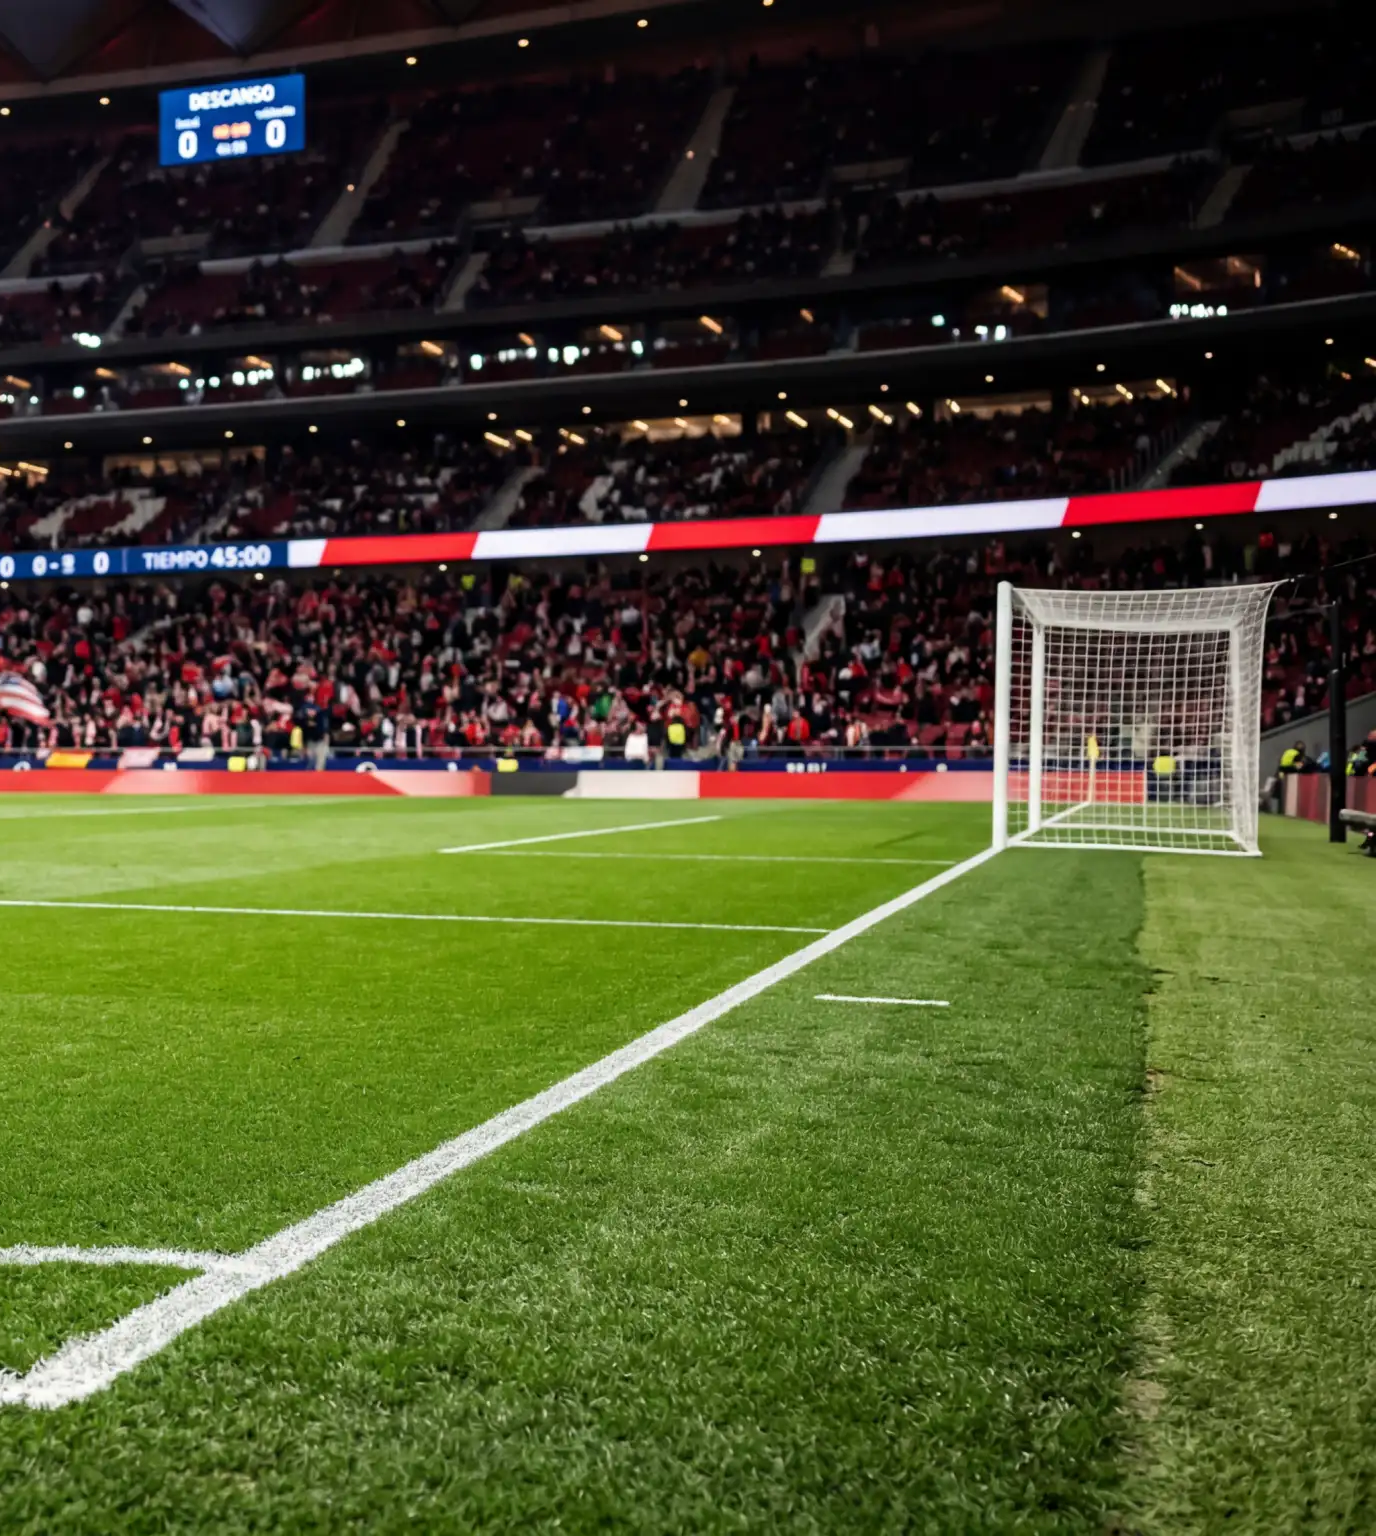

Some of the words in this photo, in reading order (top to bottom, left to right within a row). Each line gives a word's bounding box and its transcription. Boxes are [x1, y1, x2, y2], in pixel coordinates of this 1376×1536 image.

[189, 84, 275, 111] DESCANSO
[178, 131, 198, 159] 0
[265, 119, 286, 148] 0
[0, 556, 15, 578] 0
[93, 551, 109, 574] 0
[142, 550, 208, 570] TIEMPO
[211, 544, 272, 567] 45:00
